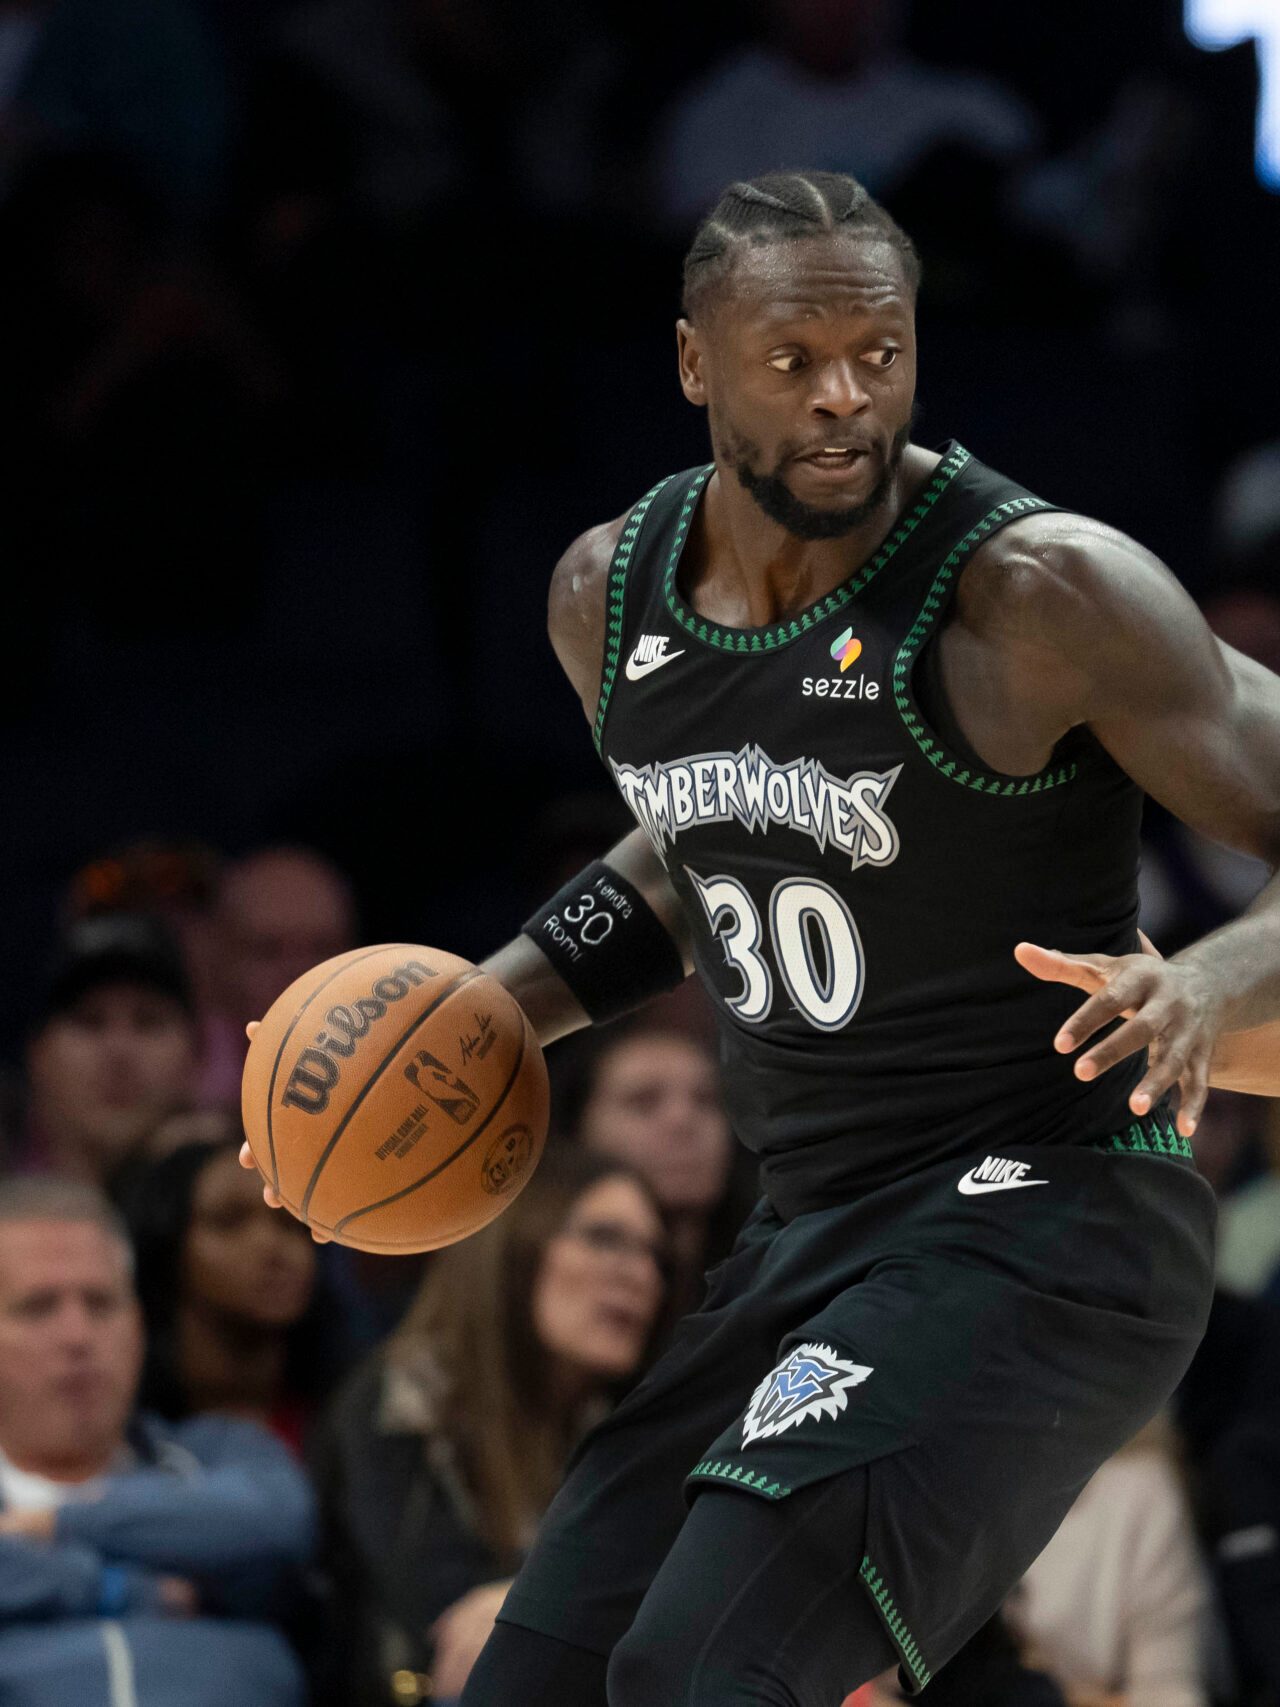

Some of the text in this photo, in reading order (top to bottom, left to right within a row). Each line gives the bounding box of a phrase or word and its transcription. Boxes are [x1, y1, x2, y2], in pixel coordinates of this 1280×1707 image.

[634, 634, 670, 662] NIKE
[802, 674, 880, 700] sezzle
[608, 743, 904, 871] TIMBERWOLVES
[543, 914, 583, 962] Romi
[564, 894, 613, 945] 30
[683, 864, 866, 1031] 30
[281, 961, 440, 1115] Wilson
[974, 1156, 1031, 1183] NIKE
